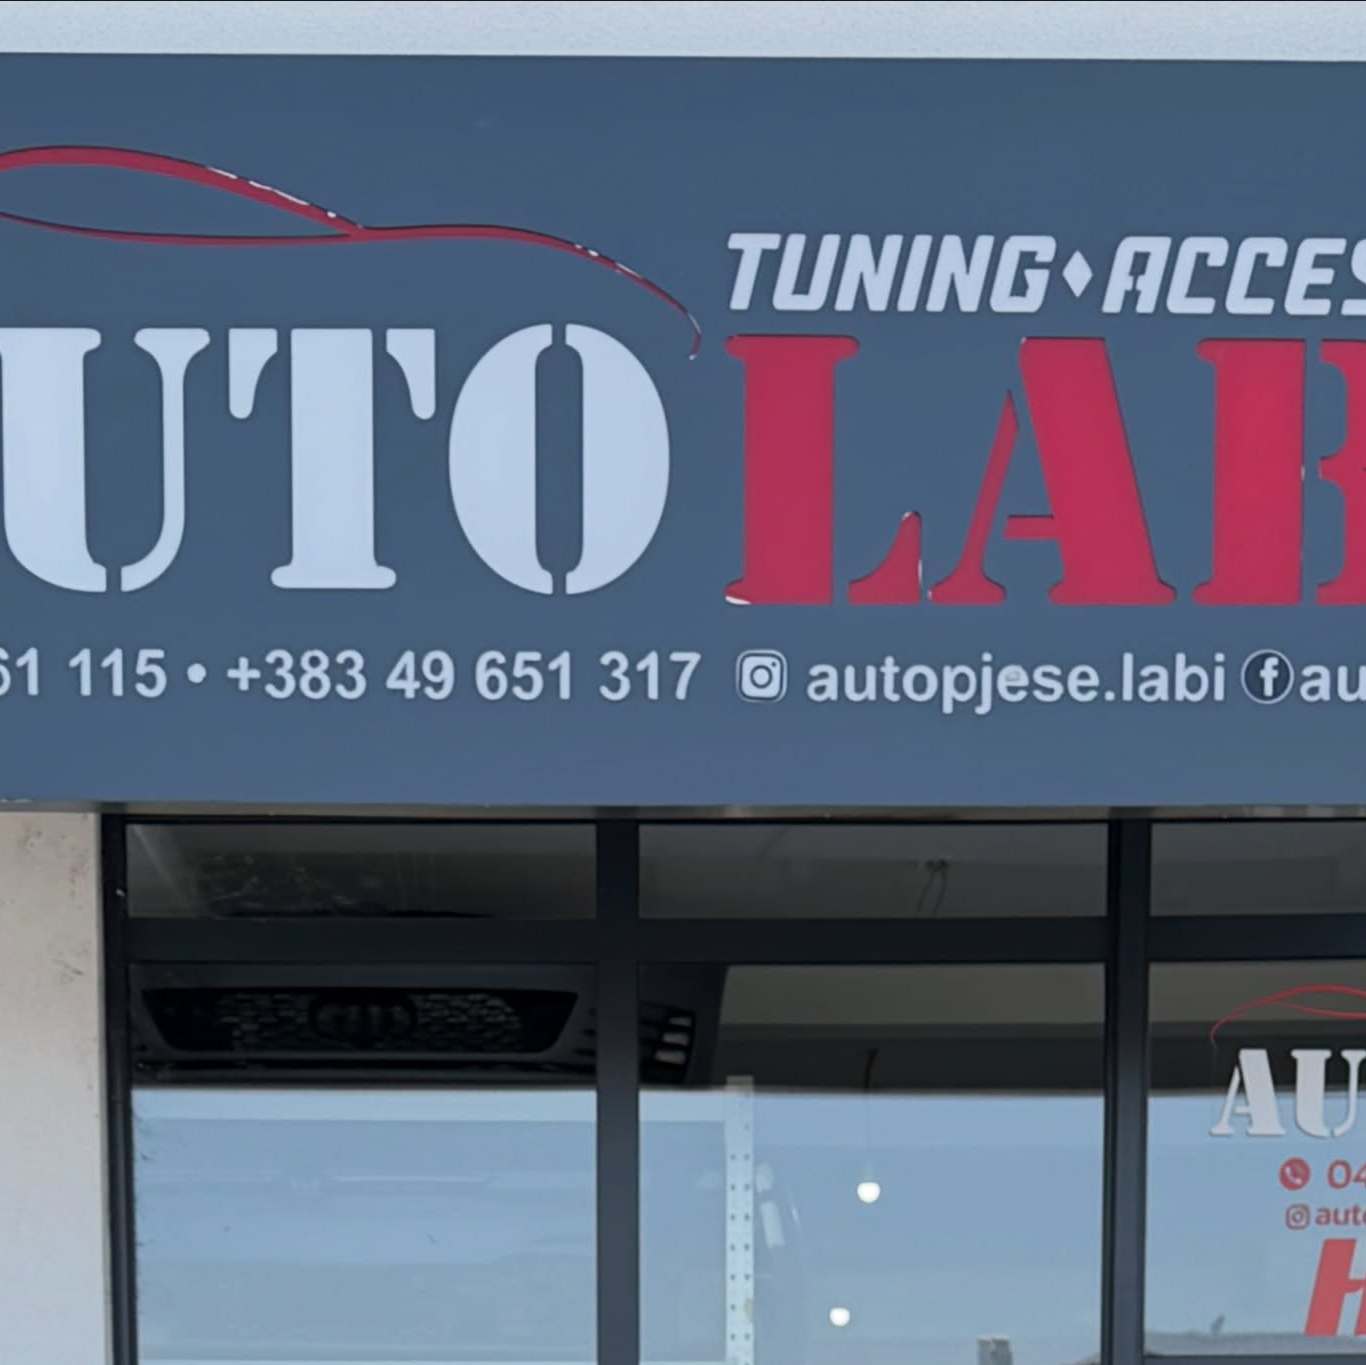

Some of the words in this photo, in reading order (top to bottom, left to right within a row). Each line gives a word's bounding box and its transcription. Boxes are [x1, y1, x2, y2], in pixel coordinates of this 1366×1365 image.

[727, 234, 1057, 313] TUNING
[69, 649, 167, 698] 115
[227, 649, 367, 700] +383
[386, 651, 455, 700] 49
[475, 651, 570, 701] 651
[600, 652, 701, 702] 317
[807, 652, 1225, 715] autopjese.labi
